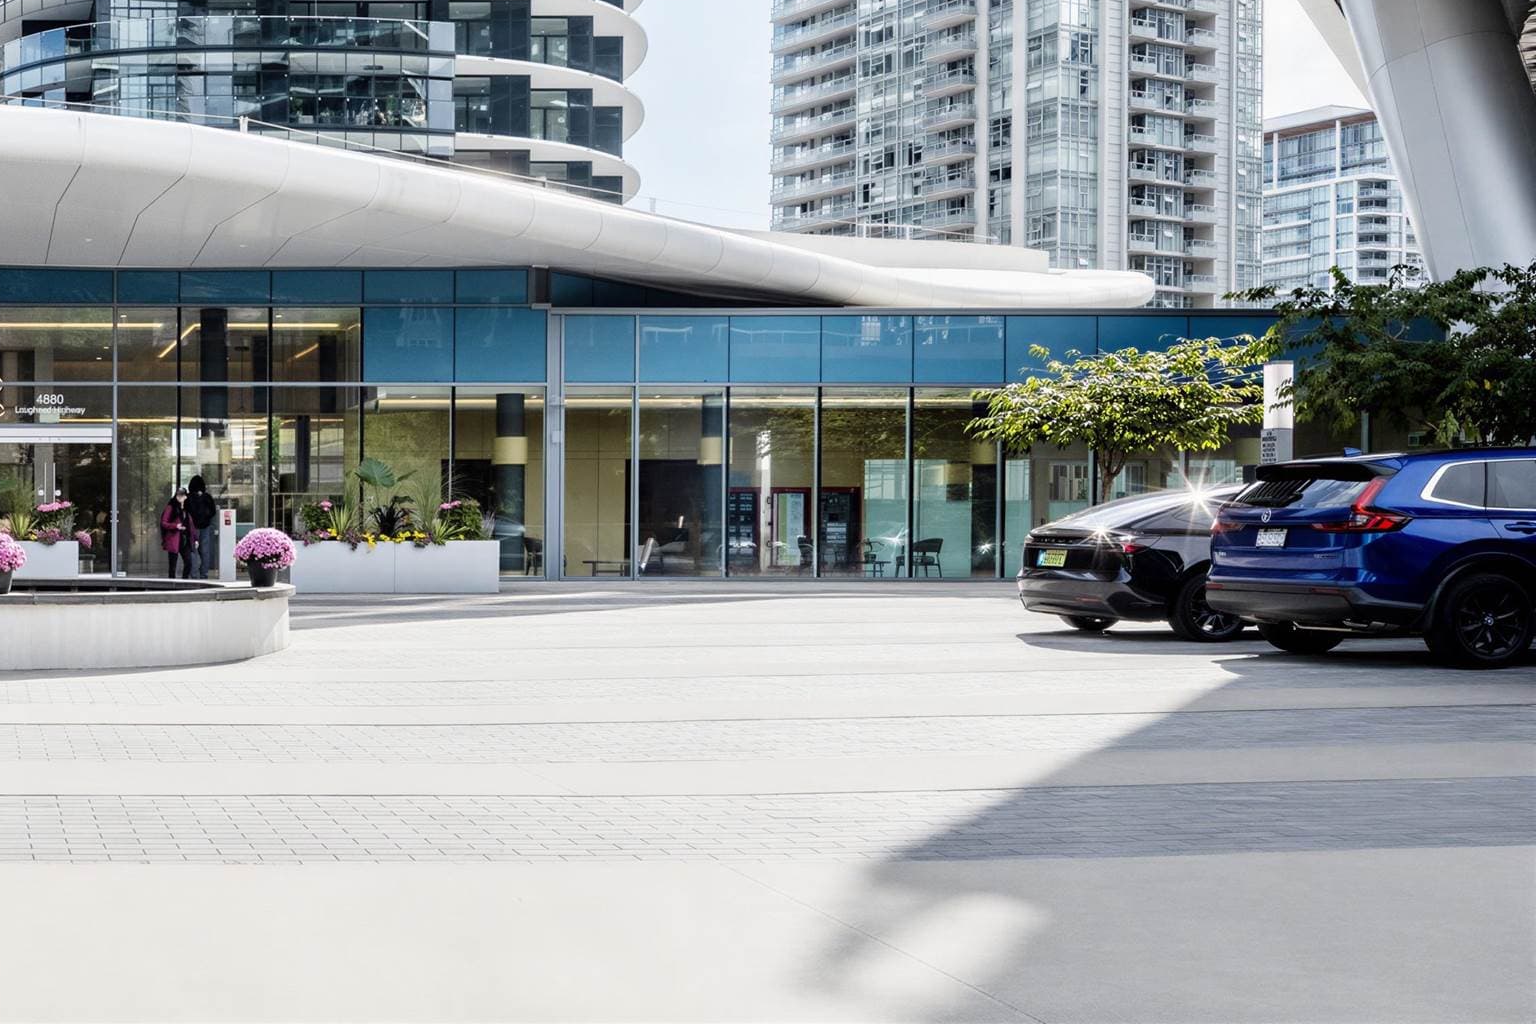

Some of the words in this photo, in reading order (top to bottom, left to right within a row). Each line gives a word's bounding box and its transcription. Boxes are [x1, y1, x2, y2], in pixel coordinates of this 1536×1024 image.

[36, 394, 64, 405] 4880
[14, 406, 52, 415] Lougheed
[53, 406, 86, 415] Highway
